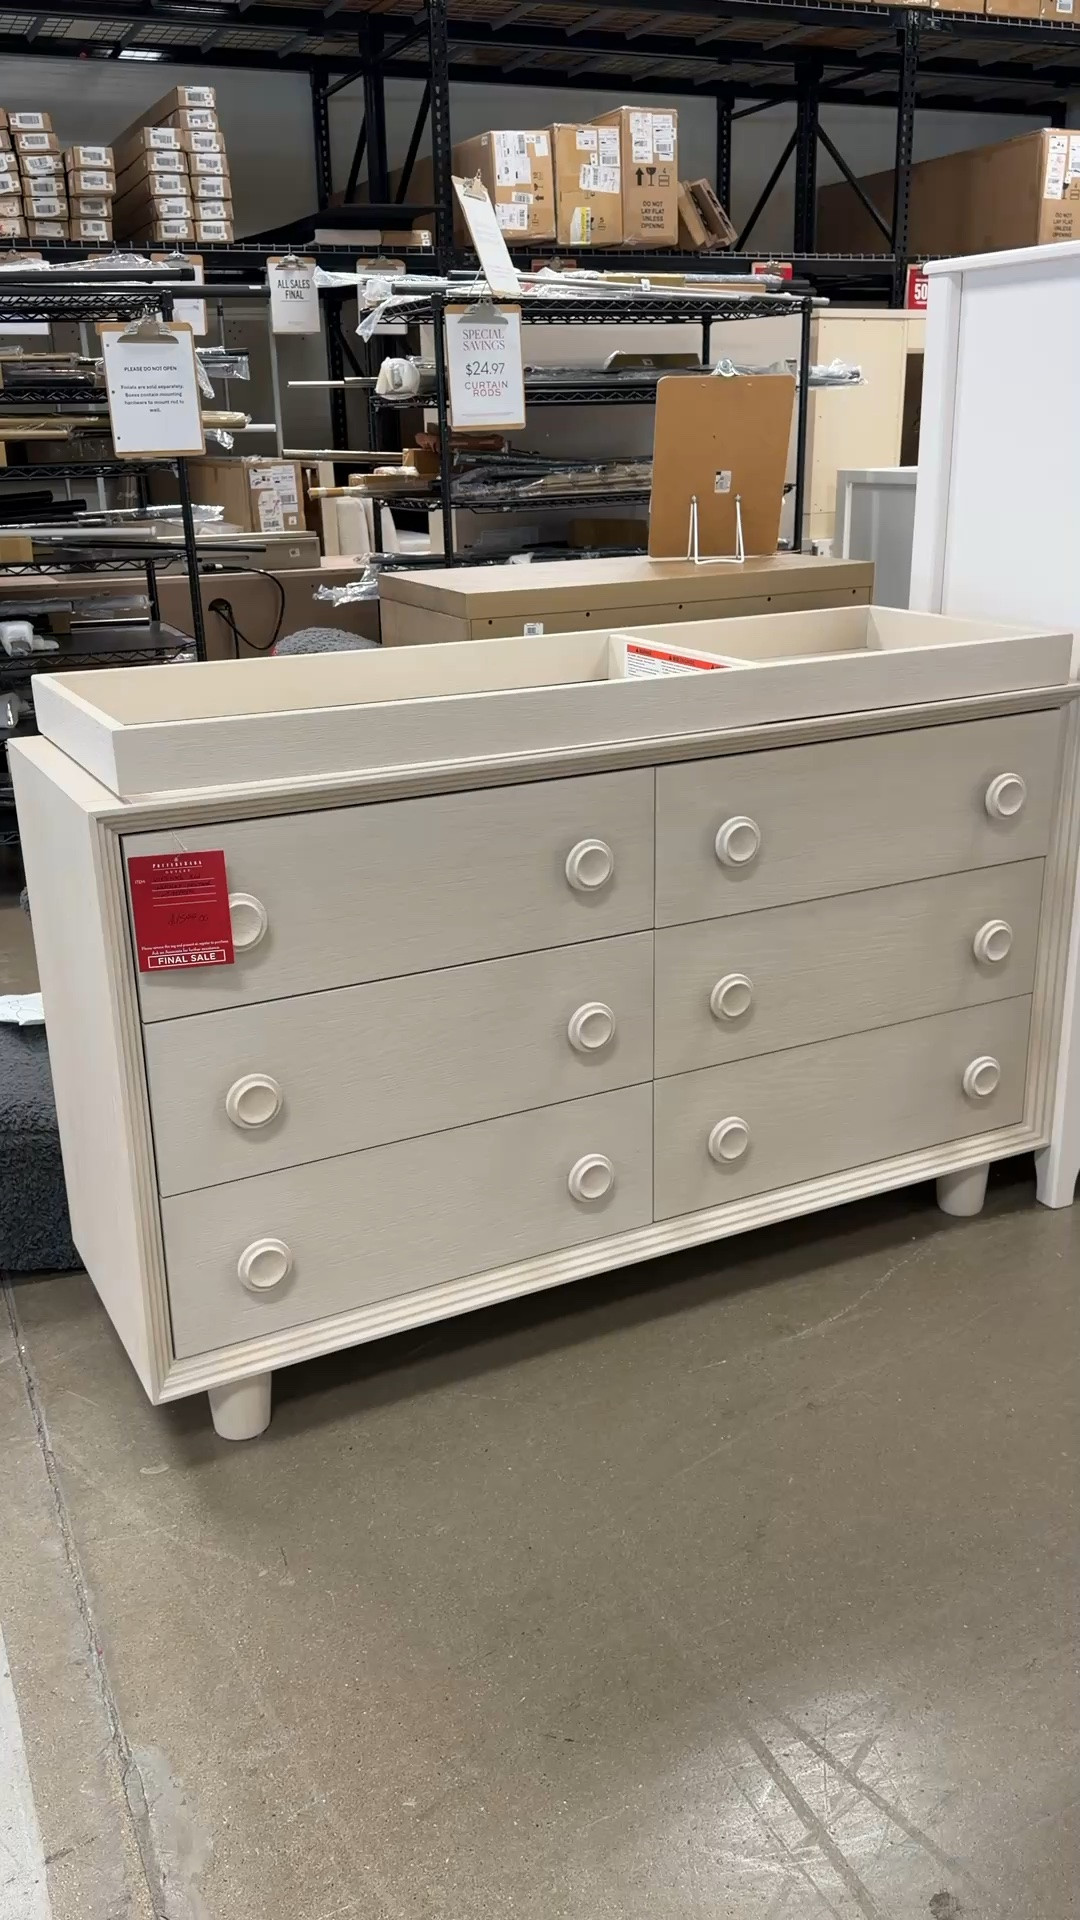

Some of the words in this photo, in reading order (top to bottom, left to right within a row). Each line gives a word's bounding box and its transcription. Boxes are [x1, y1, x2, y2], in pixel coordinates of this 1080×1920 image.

[277, 279, 289, 289] ALL
[290, 279, 310, 289] SALES
[285, 289, 304, 299] FINAL
[914, 283, 928, 300] 50
[462, 328, 505, 340] SPECIAL
[463, 340, 506, 352] SAVINGS
[465, 360, 506, 376] $24.97
[464, 380, 509, 390] CURTAIN
[473, 388, 502, 397] RODS
[158, 955, 188, 965] FINAL
[191, 952, 216, 962] SALE
